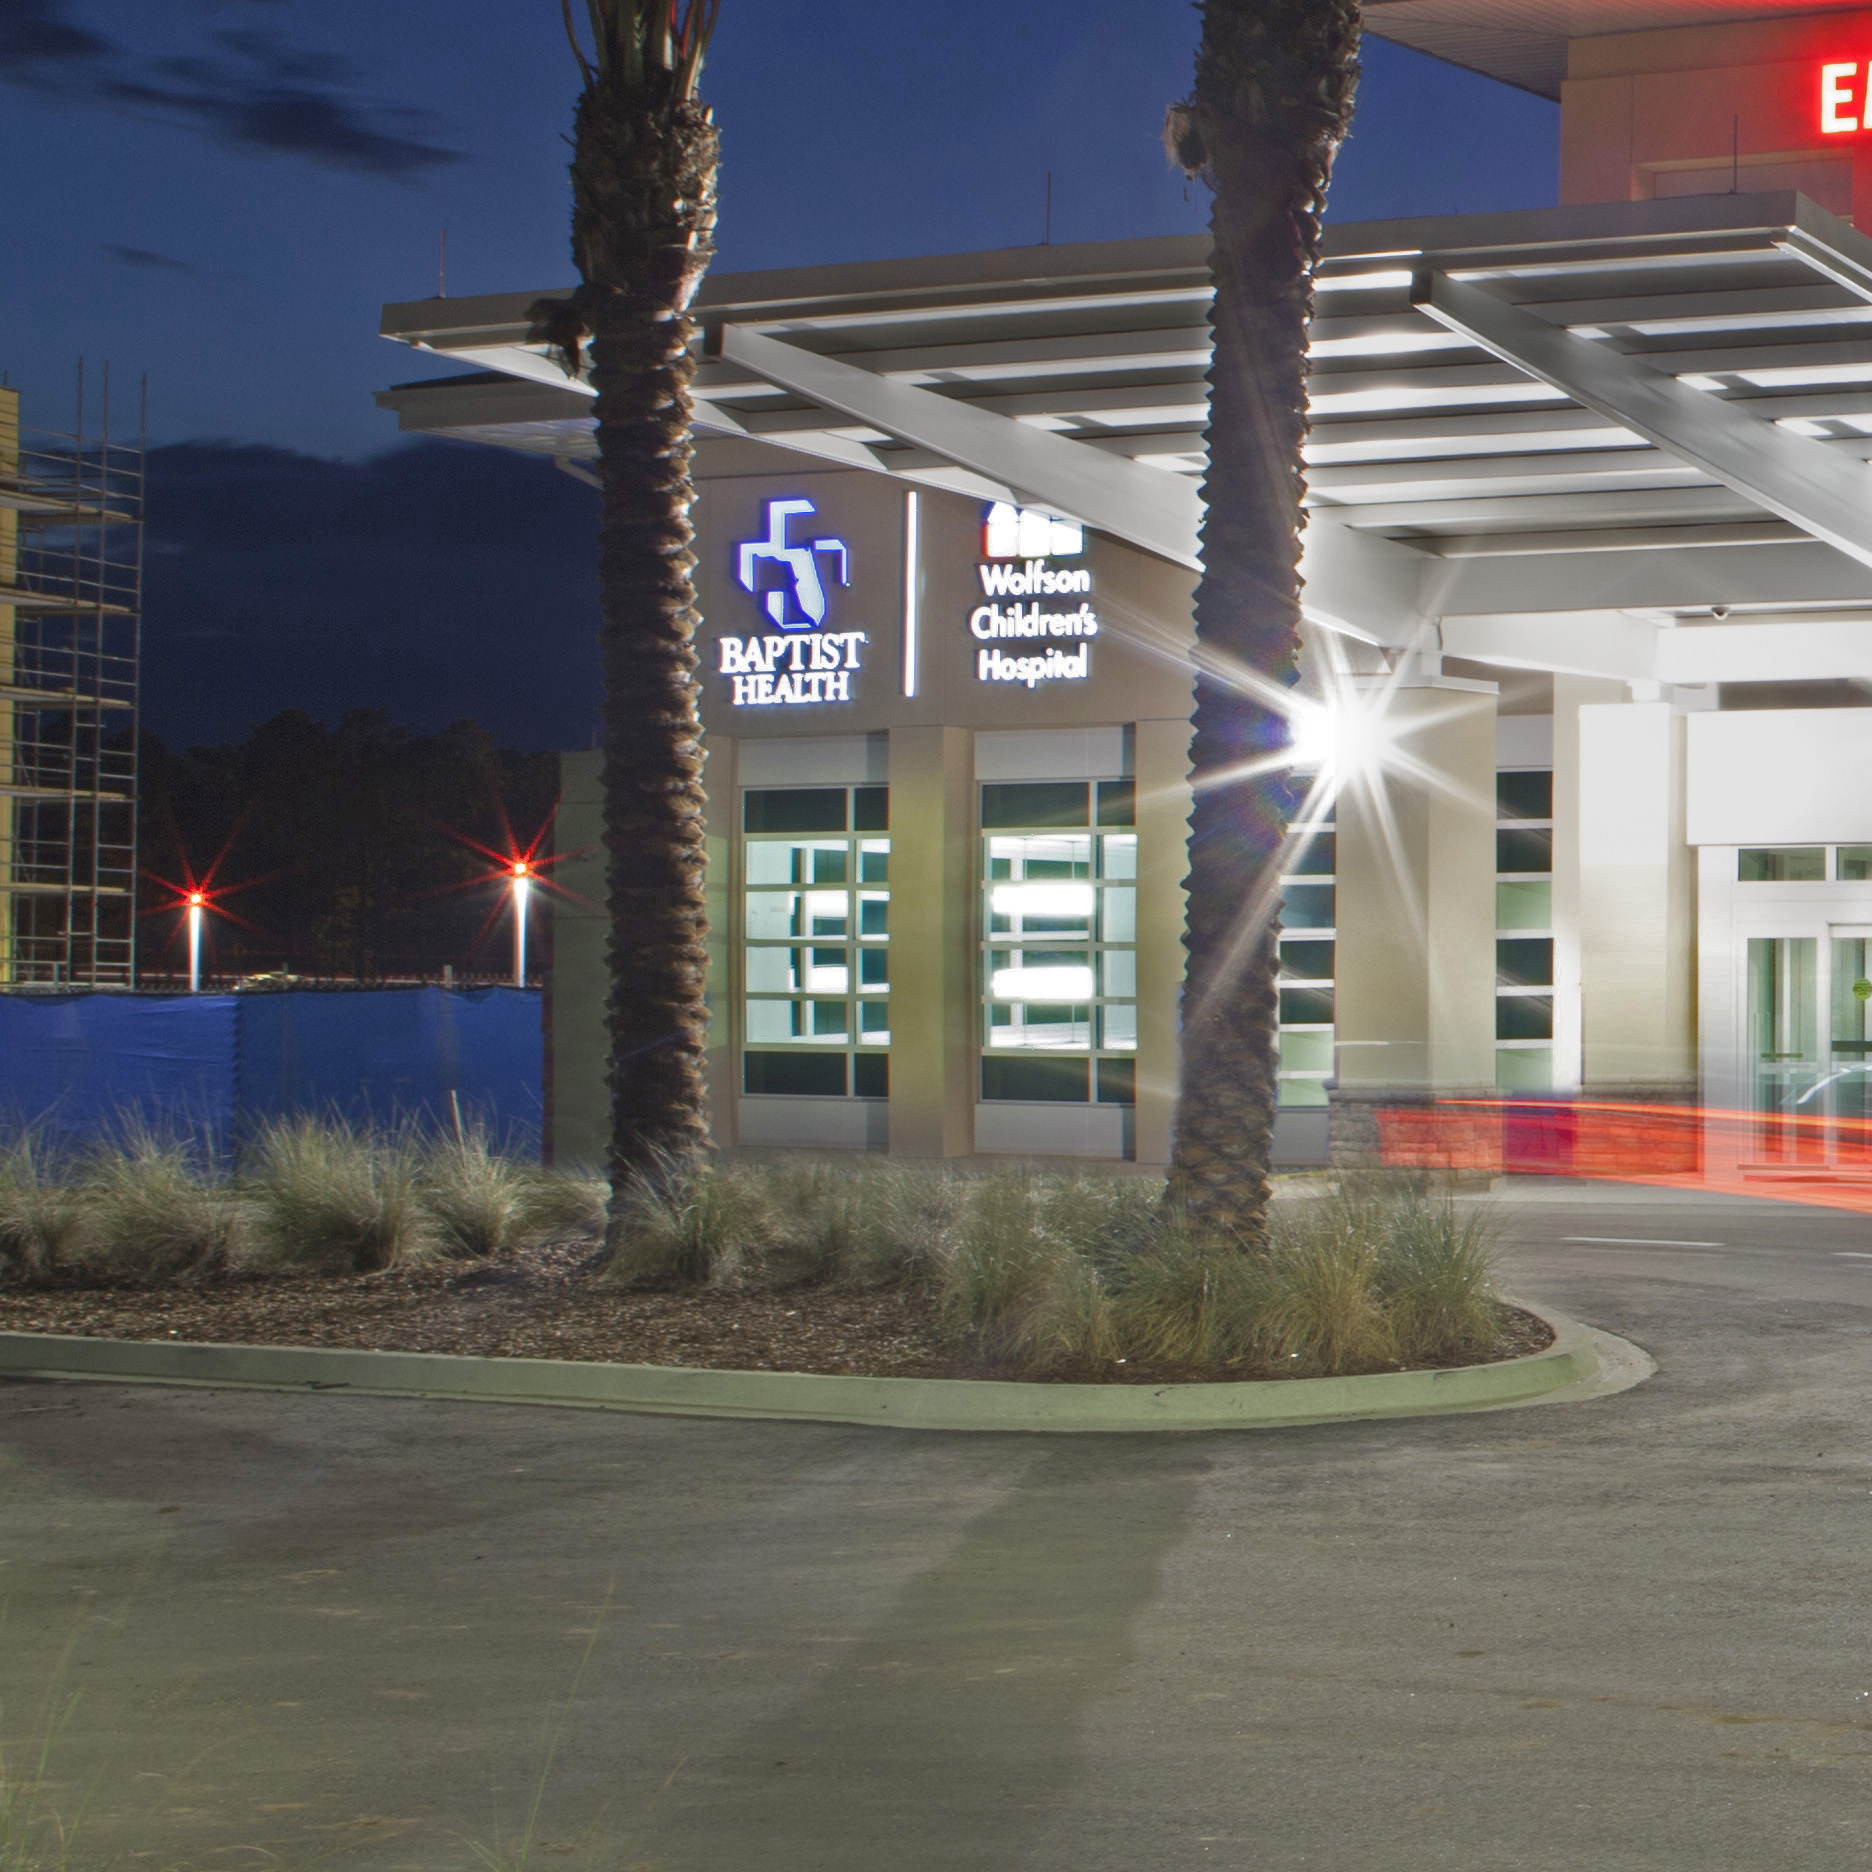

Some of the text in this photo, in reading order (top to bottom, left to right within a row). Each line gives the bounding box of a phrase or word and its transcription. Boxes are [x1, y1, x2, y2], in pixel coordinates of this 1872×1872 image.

[978, 558, 1091, 597] Wolfson
[970, 601, 1099, 640] Children's
[718, 631, 866, 674] BAPTIST
[977, 642, 1088, 689] Hospital
[732, 670, 850, 706] HEALTH
